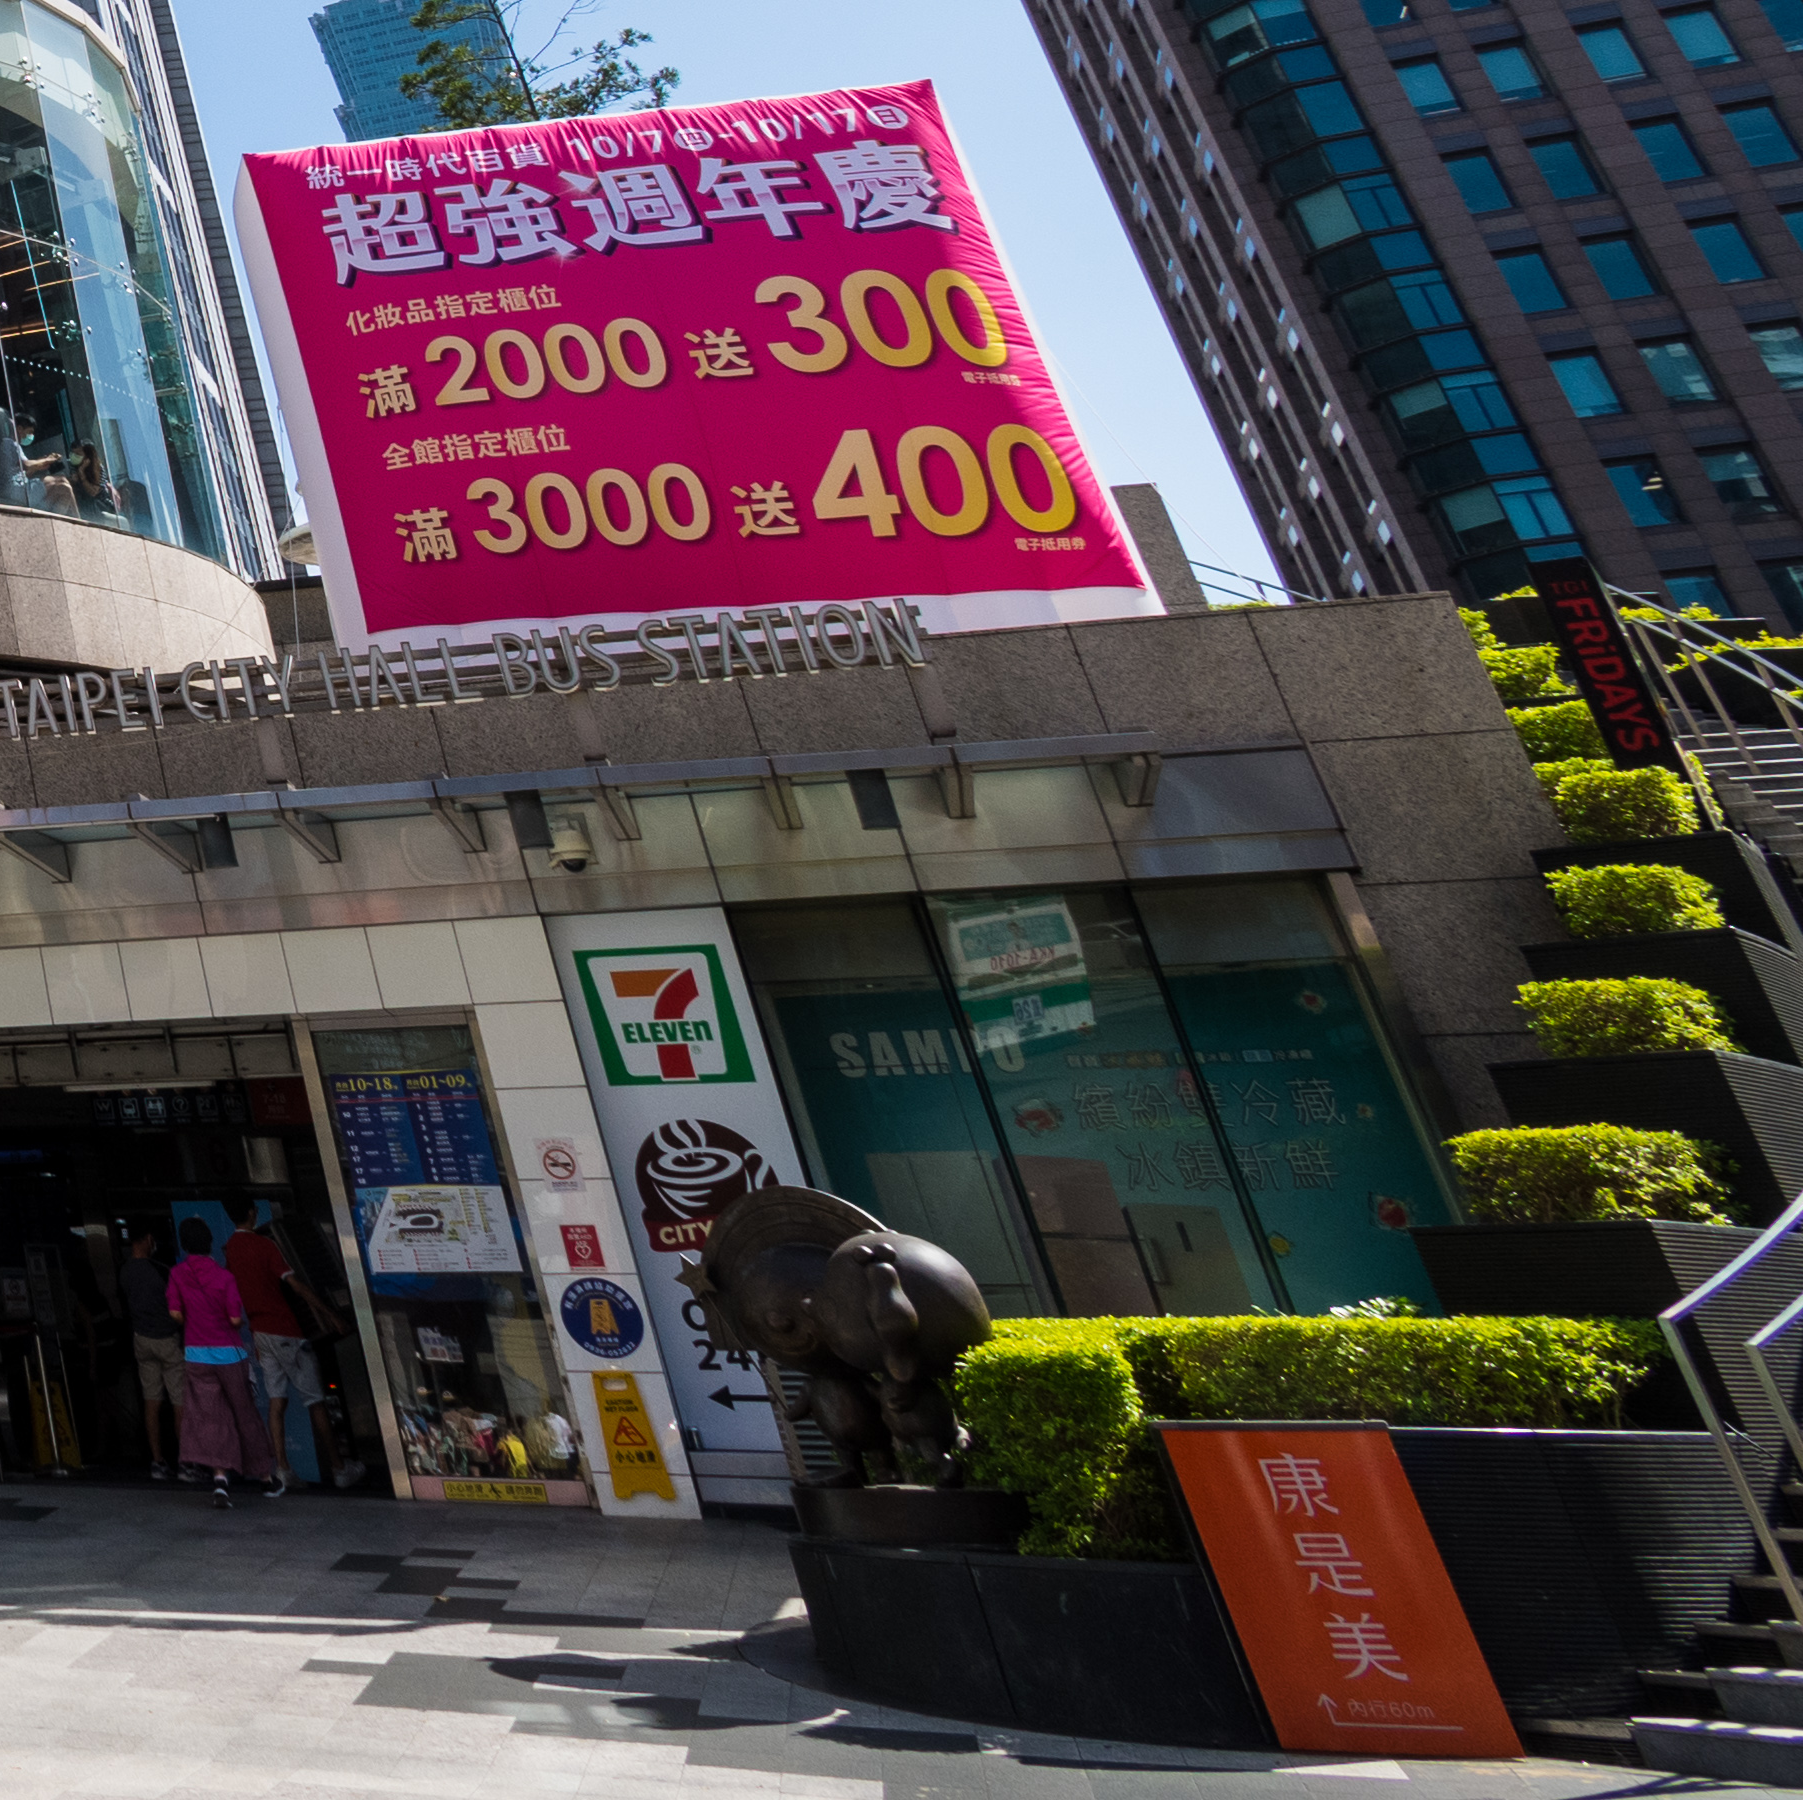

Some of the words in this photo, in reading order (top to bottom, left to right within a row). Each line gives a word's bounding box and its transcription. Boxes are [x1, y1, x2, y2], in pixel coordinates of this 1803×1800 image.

[305, 141, 550, 190] 統一時代百貨
[321, 139, 959, 288] 超強週年慶
[346, 283, 562, 336] 化妝品指定櫃位
[357, 365, 417, 418] 滿
[424, 317, 669, 407] 2000
[684, 327, 755, 380] 送
[754, 268, 1009, 374] 300
[382, 424, 571, 471] 全館指定櫃位
[394, 506, 456, 563] 滿
[466, 462, 711, 554] 3000
[733, 481, 800, 538] 送
[812, 423, 1077, 538] 400
[1014, 537, 1087, 551] 電子抵用券
[182, 654, 295, 724] CITY
[317, 636, 483, 714] HALL
[492, 624, 621, 701] BUS
[637, 597, 929, 687] STATION
[1115, 1140, 1340, 1191] 冰鎮新鮮
[659, 1220, 714, 1246] CITY
[1257, 1452, 1410, 1683] 康是美
